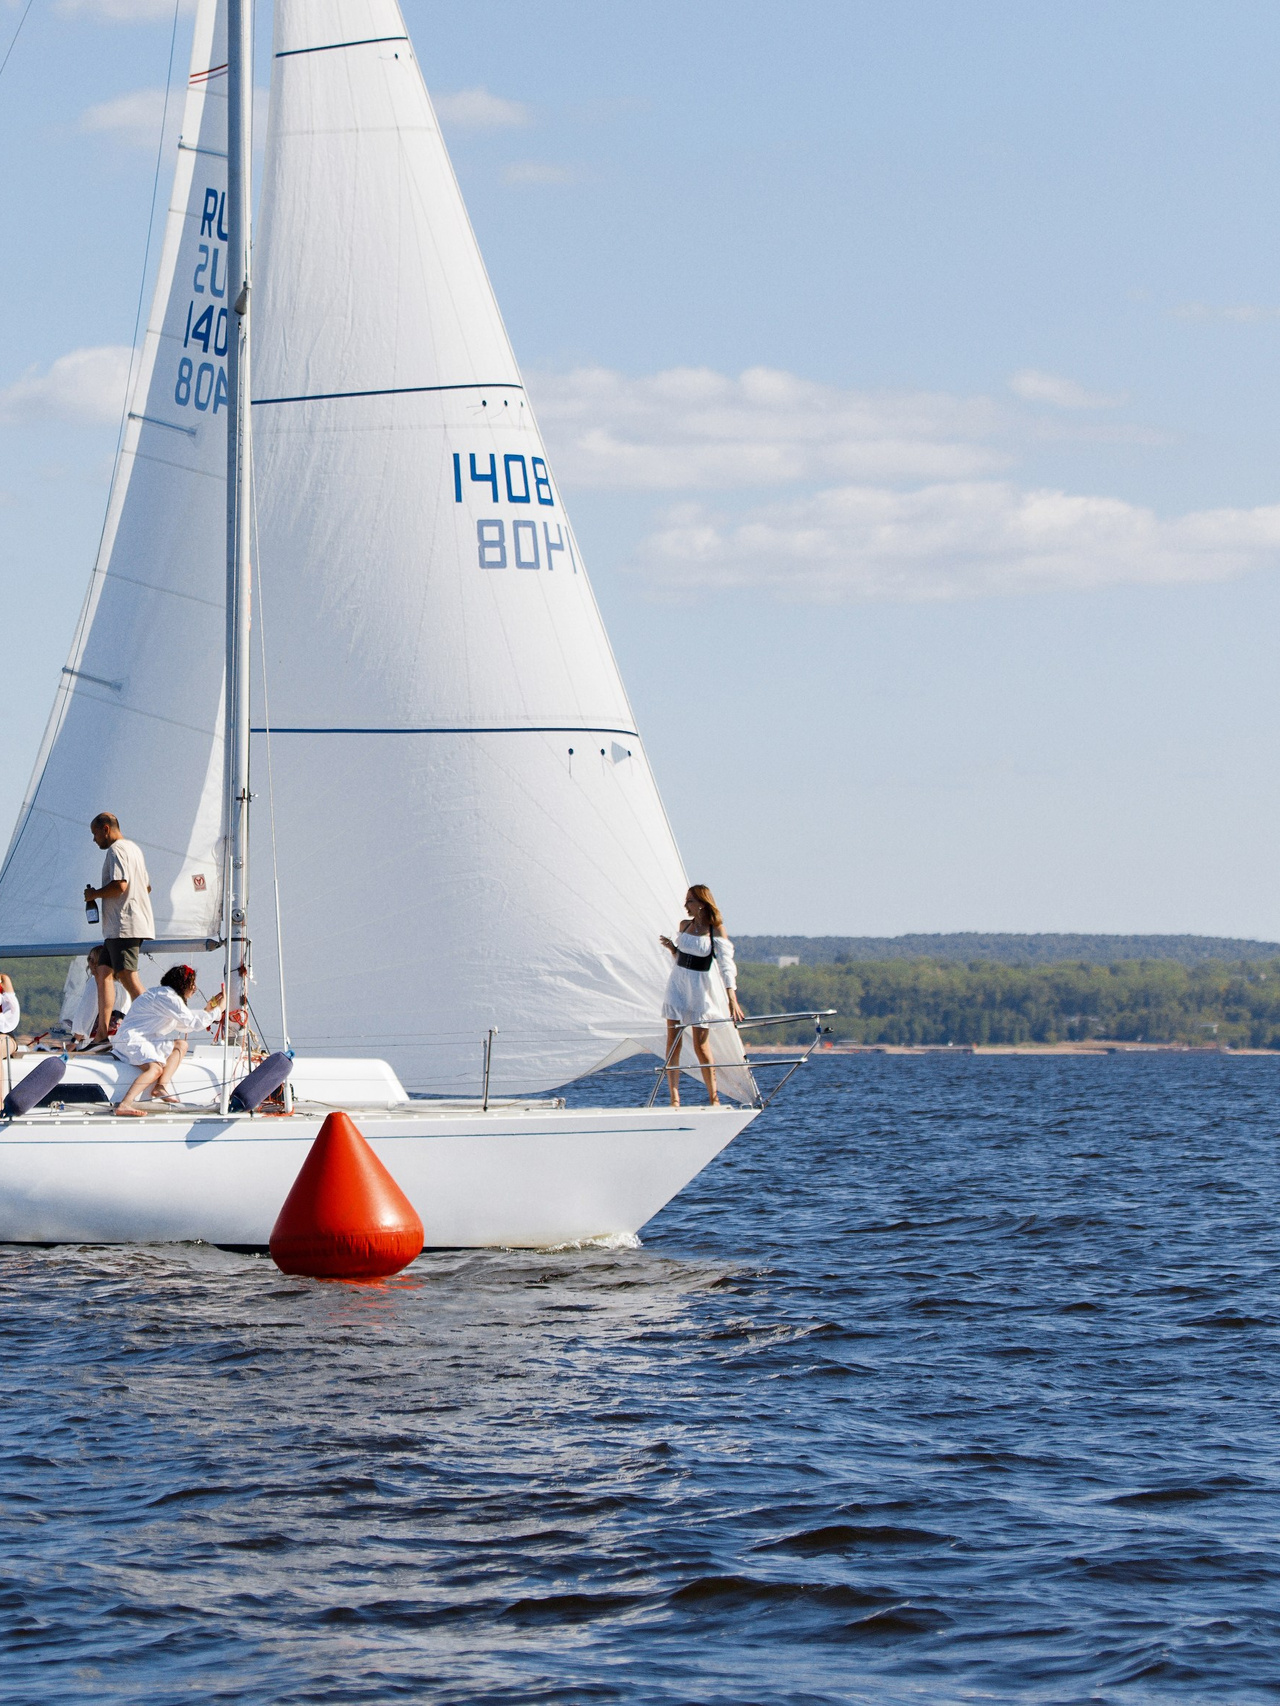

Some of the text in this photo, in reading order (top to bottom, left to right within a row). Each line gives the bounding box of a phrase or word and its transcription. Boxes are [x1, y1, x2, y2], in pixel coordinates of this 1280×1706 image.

[200, 188, 228, 242] RU
[183, 300, 228, 357] 140
[453, 453, 554, 507] 1408
